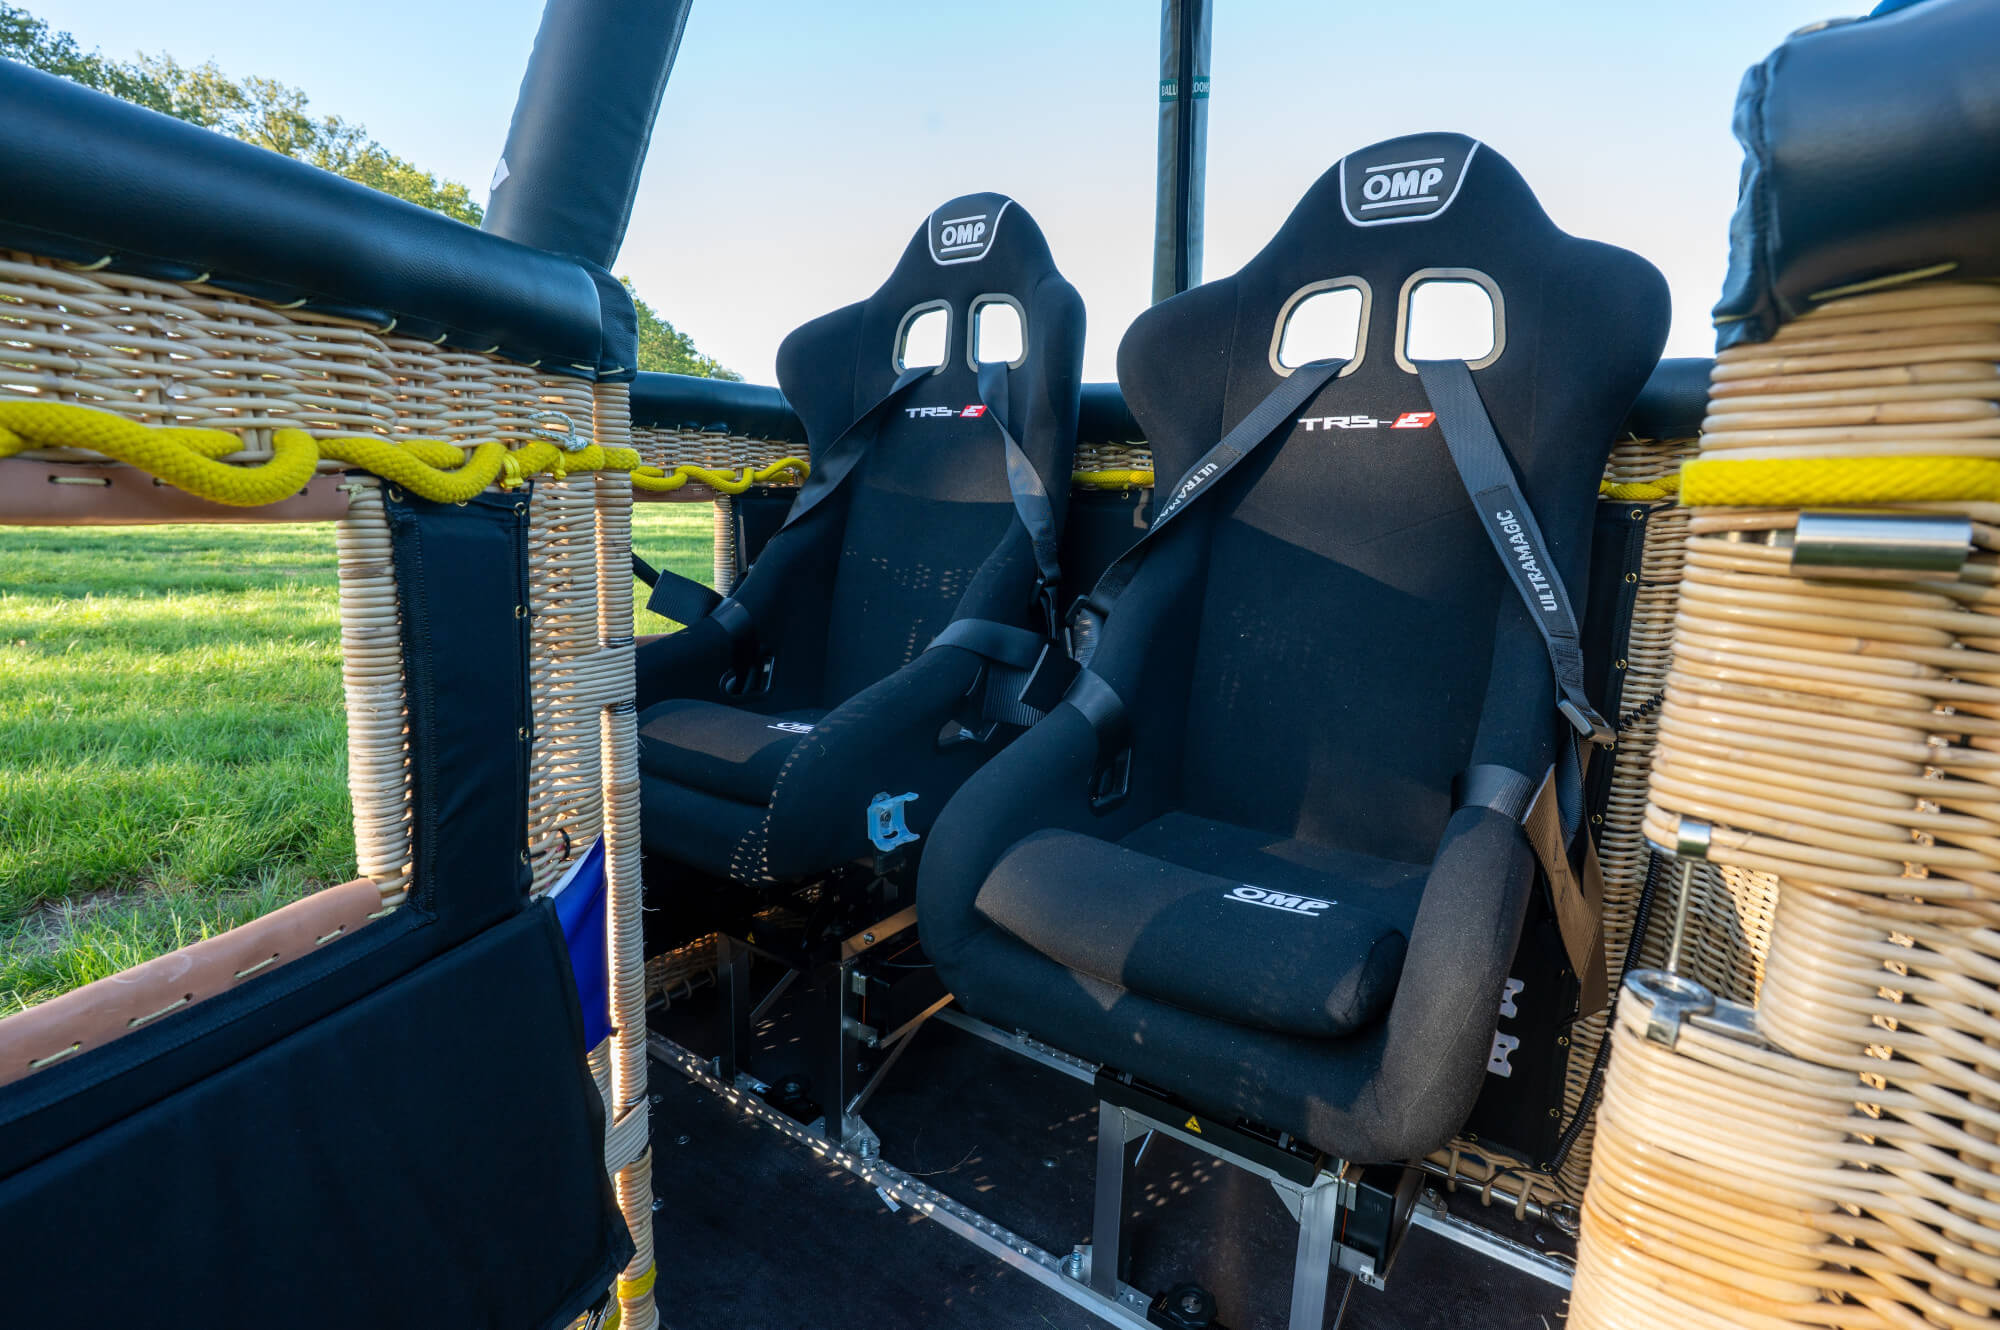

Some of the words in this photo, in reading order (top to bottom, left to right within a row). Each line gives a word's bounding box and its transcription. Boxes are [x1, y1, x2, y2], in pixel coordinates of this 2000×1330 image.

[1363, 167, 1443, 201] OMP
[941, 221, 986, 246] OMP
[904, 404, 986, 419] TRS-E
[1297, 411, 1437, 431] TRS-E
[1496, 509, 1558, 612] ULTRAMAGIC
[1232, 887, 1330, 910] OMP
